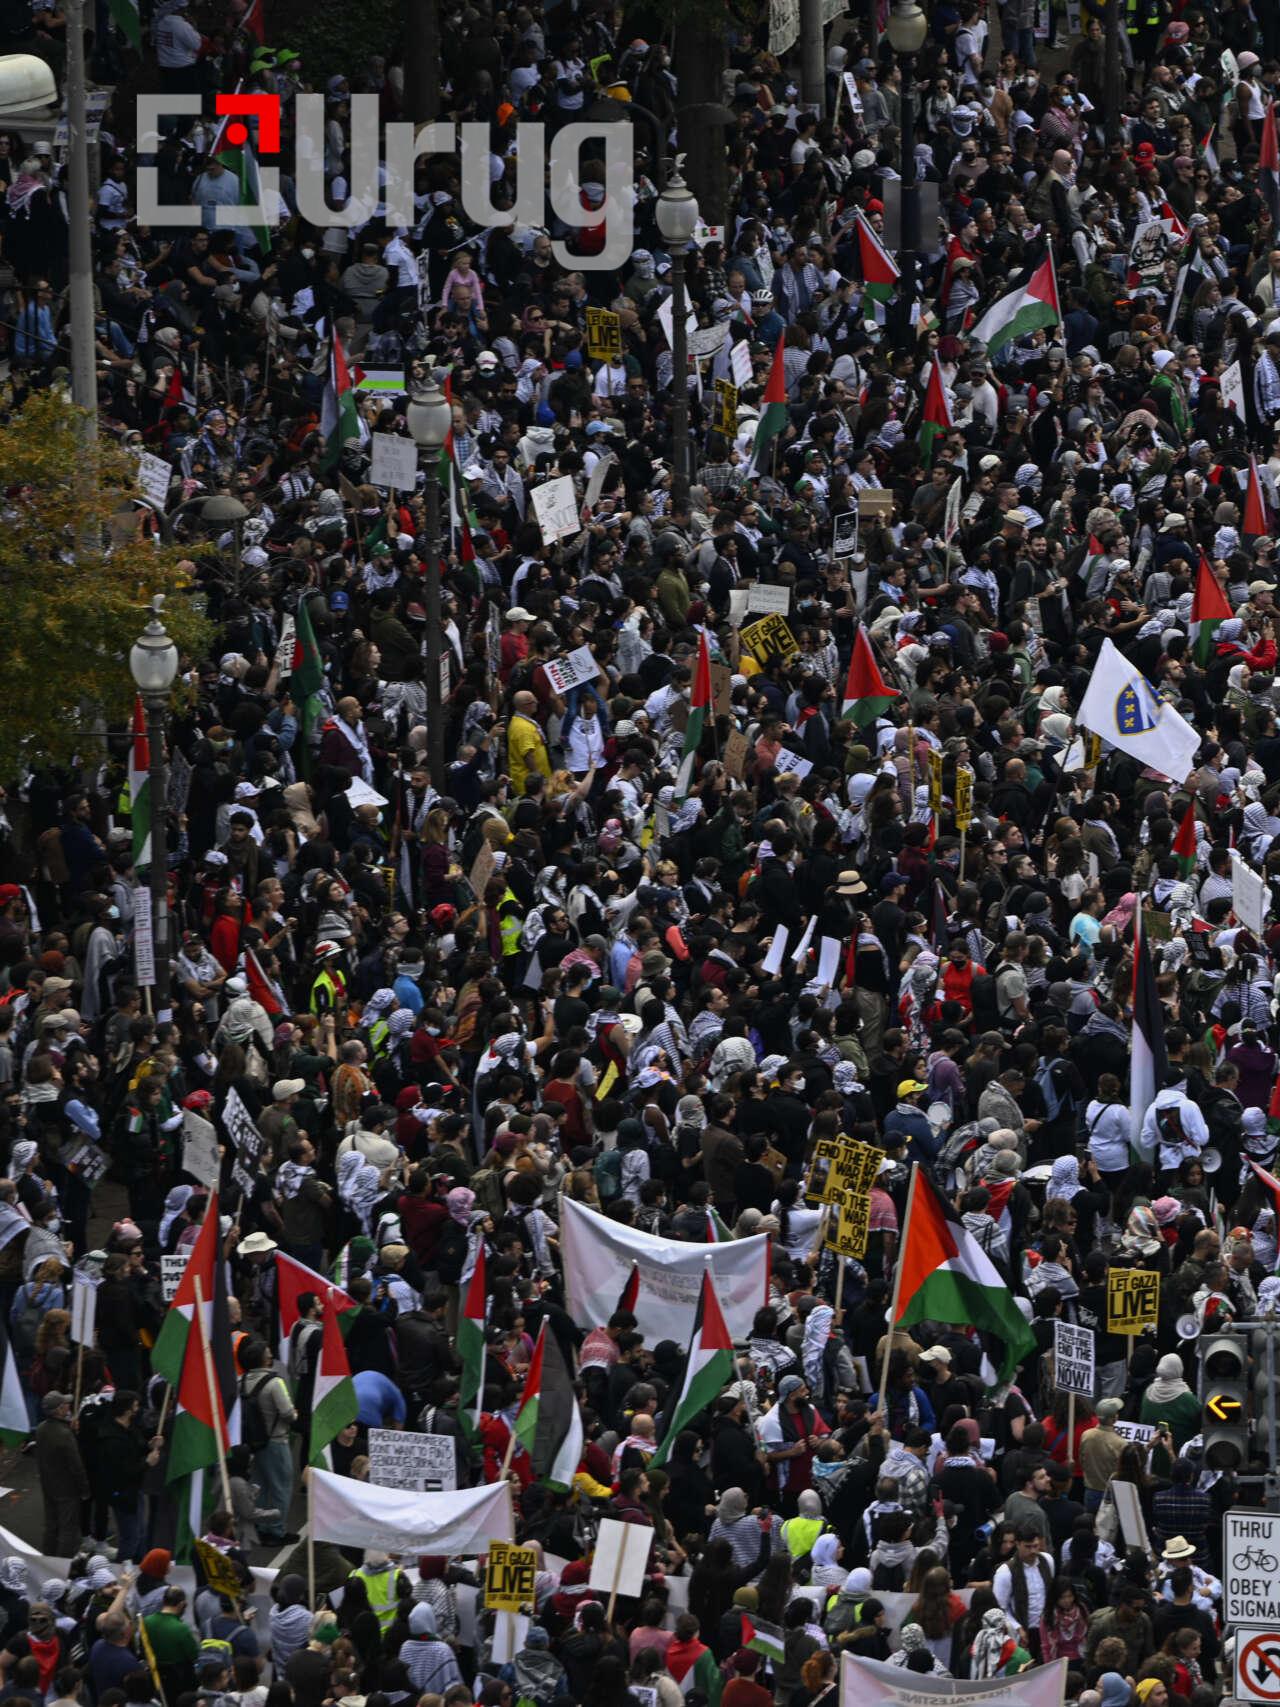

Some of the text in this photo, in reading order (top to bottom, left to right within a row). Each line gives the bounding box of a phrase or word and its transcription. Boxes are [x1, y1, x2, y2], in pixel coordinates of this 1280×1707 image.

[587, 326, 621, 347] LIVE!
[817, 1142, 864, 1164] END THE
[835, 1161, 860, 1179] WAR
[830, 1188, 869, 1212] END THE
[845, 1209, 867, 1226] WAR
[852, 1225, 866, 1240] ON
[840, 1235, 864, 1252] GAZA
[1111, 1274, 1157, 1292] LET GAZA
[1111, 1290, 1157, 1319] LIVE!
[1057, 1341, 1092, 1361] END THE
[1057, 1368, 1091, 1391] NOW!
[1134, 1428, 1151, 1442] ALL
[1231, 1520, 1272, 1540] THRU
[491, 1550, 535, 1566] LET GAZA
[488, 1565, 535, 1594] LIVE!
[1230, 1579, 1272, 1597] OBEY
